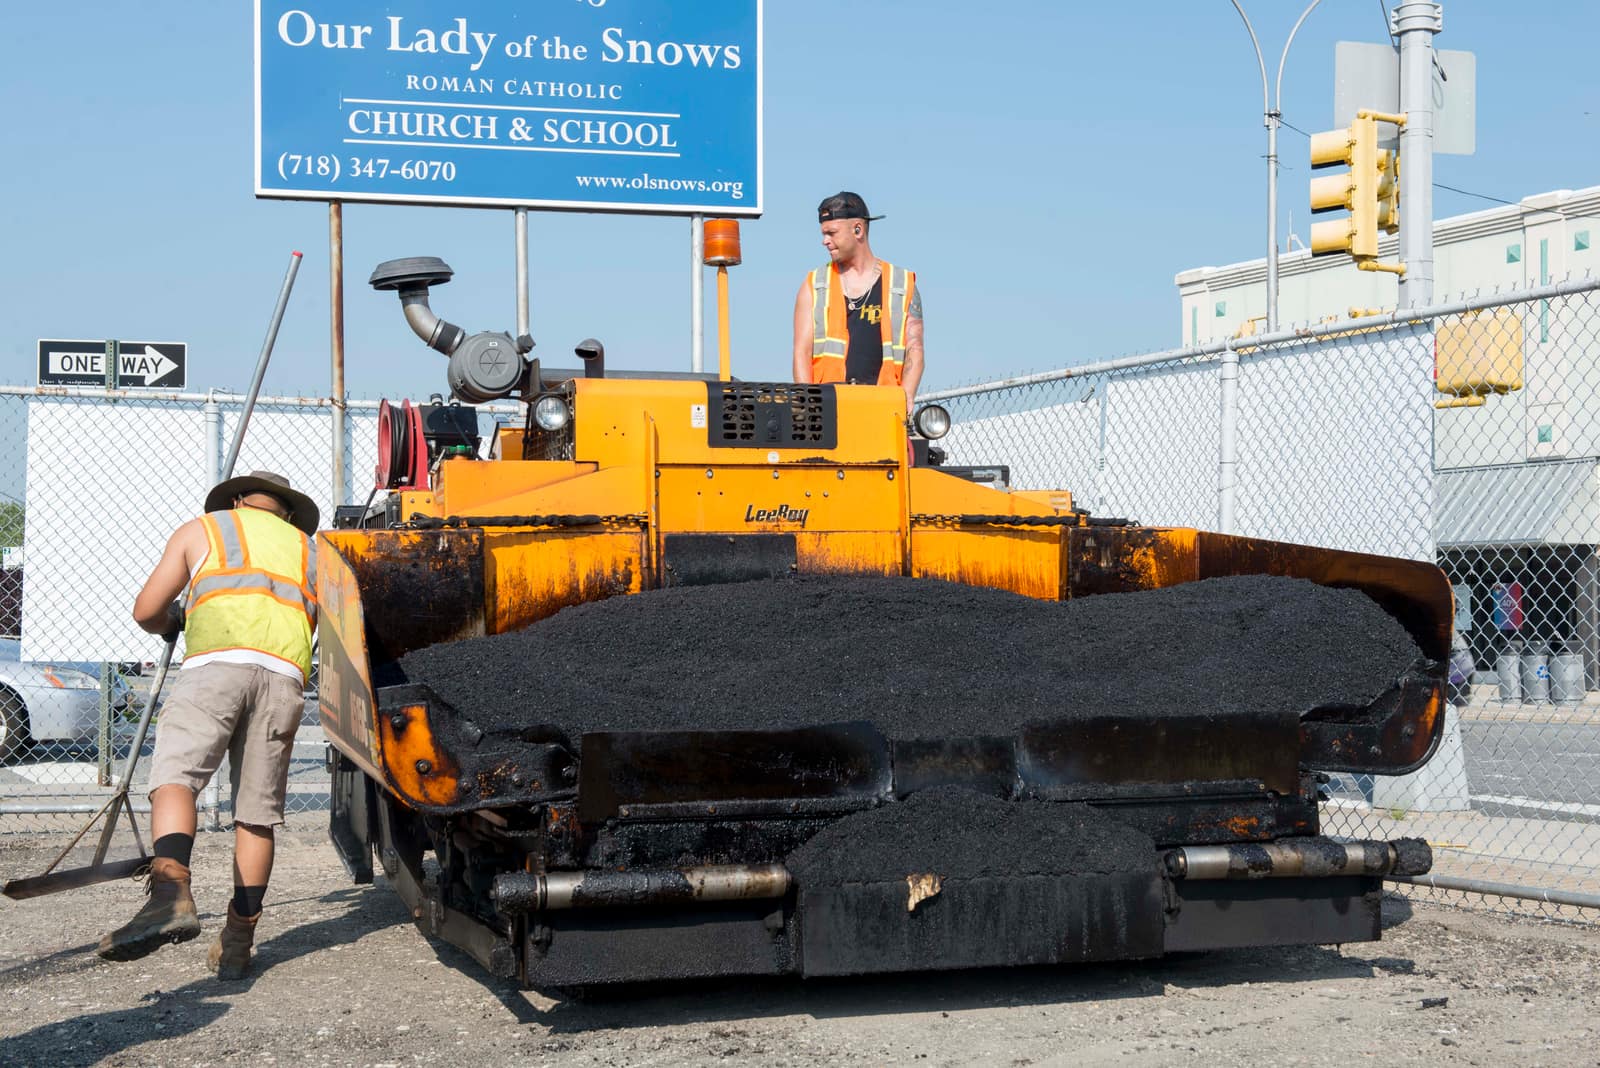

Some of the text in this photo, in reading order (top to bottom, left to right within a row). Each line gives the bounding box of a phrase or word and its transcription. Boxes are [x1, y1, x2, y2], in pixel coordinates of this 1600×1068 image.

[277, 9, 741, 71] Our Lady of the Snows
[407, 74, 622, 100] ROMAN CATHOLIC
[348, 109, 677, 148] CHURCH & SCHOOL
[277, 151, 456, 183] (718) 347-6070
[576, 173, 744, 199] www.olsnows.org
[60, 354, 164, 374] ONE WAY
